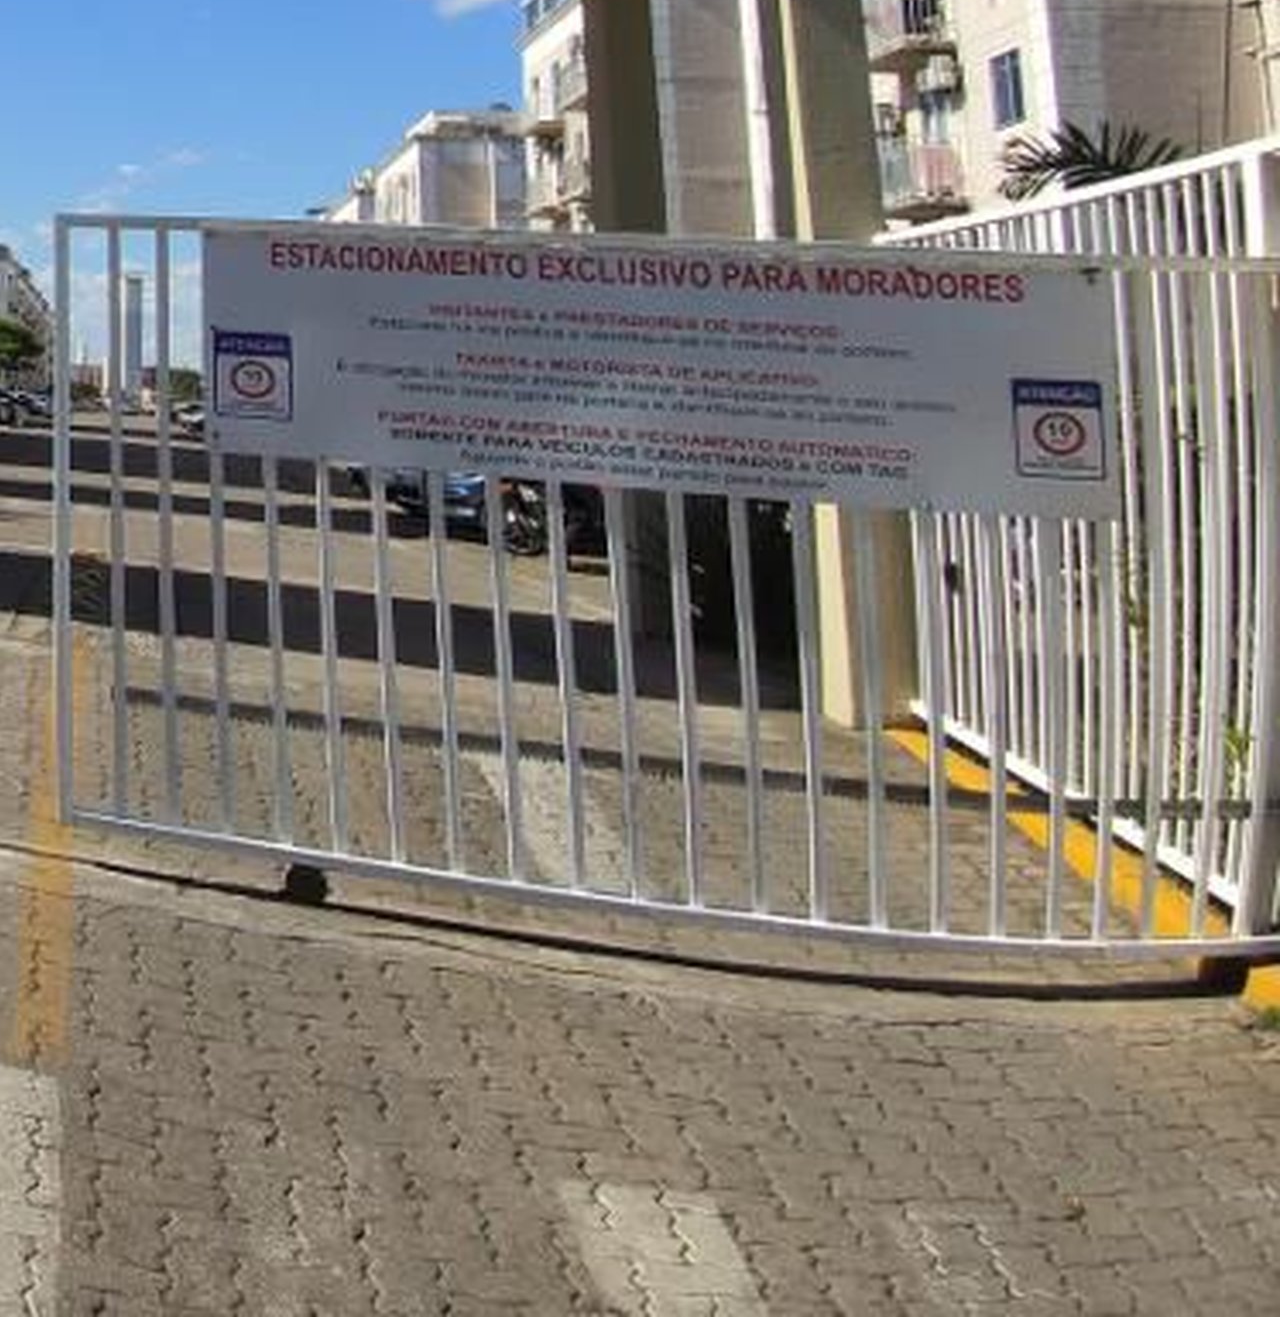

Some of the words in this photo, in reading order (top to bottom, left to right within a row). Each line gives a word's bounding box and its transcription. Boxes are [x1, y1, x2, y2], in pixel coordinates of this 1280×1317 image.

[270, 242, 528, 280] ESTACIONAMENTO
[538, 253, 712, 289] EXCLUSIVO
[722, 263, 808, 292] PARA
[818, 267, 1025, 303] MORADORES
[483, 434, 533, 449] PARA
[816, 460, 863, 476] COM
